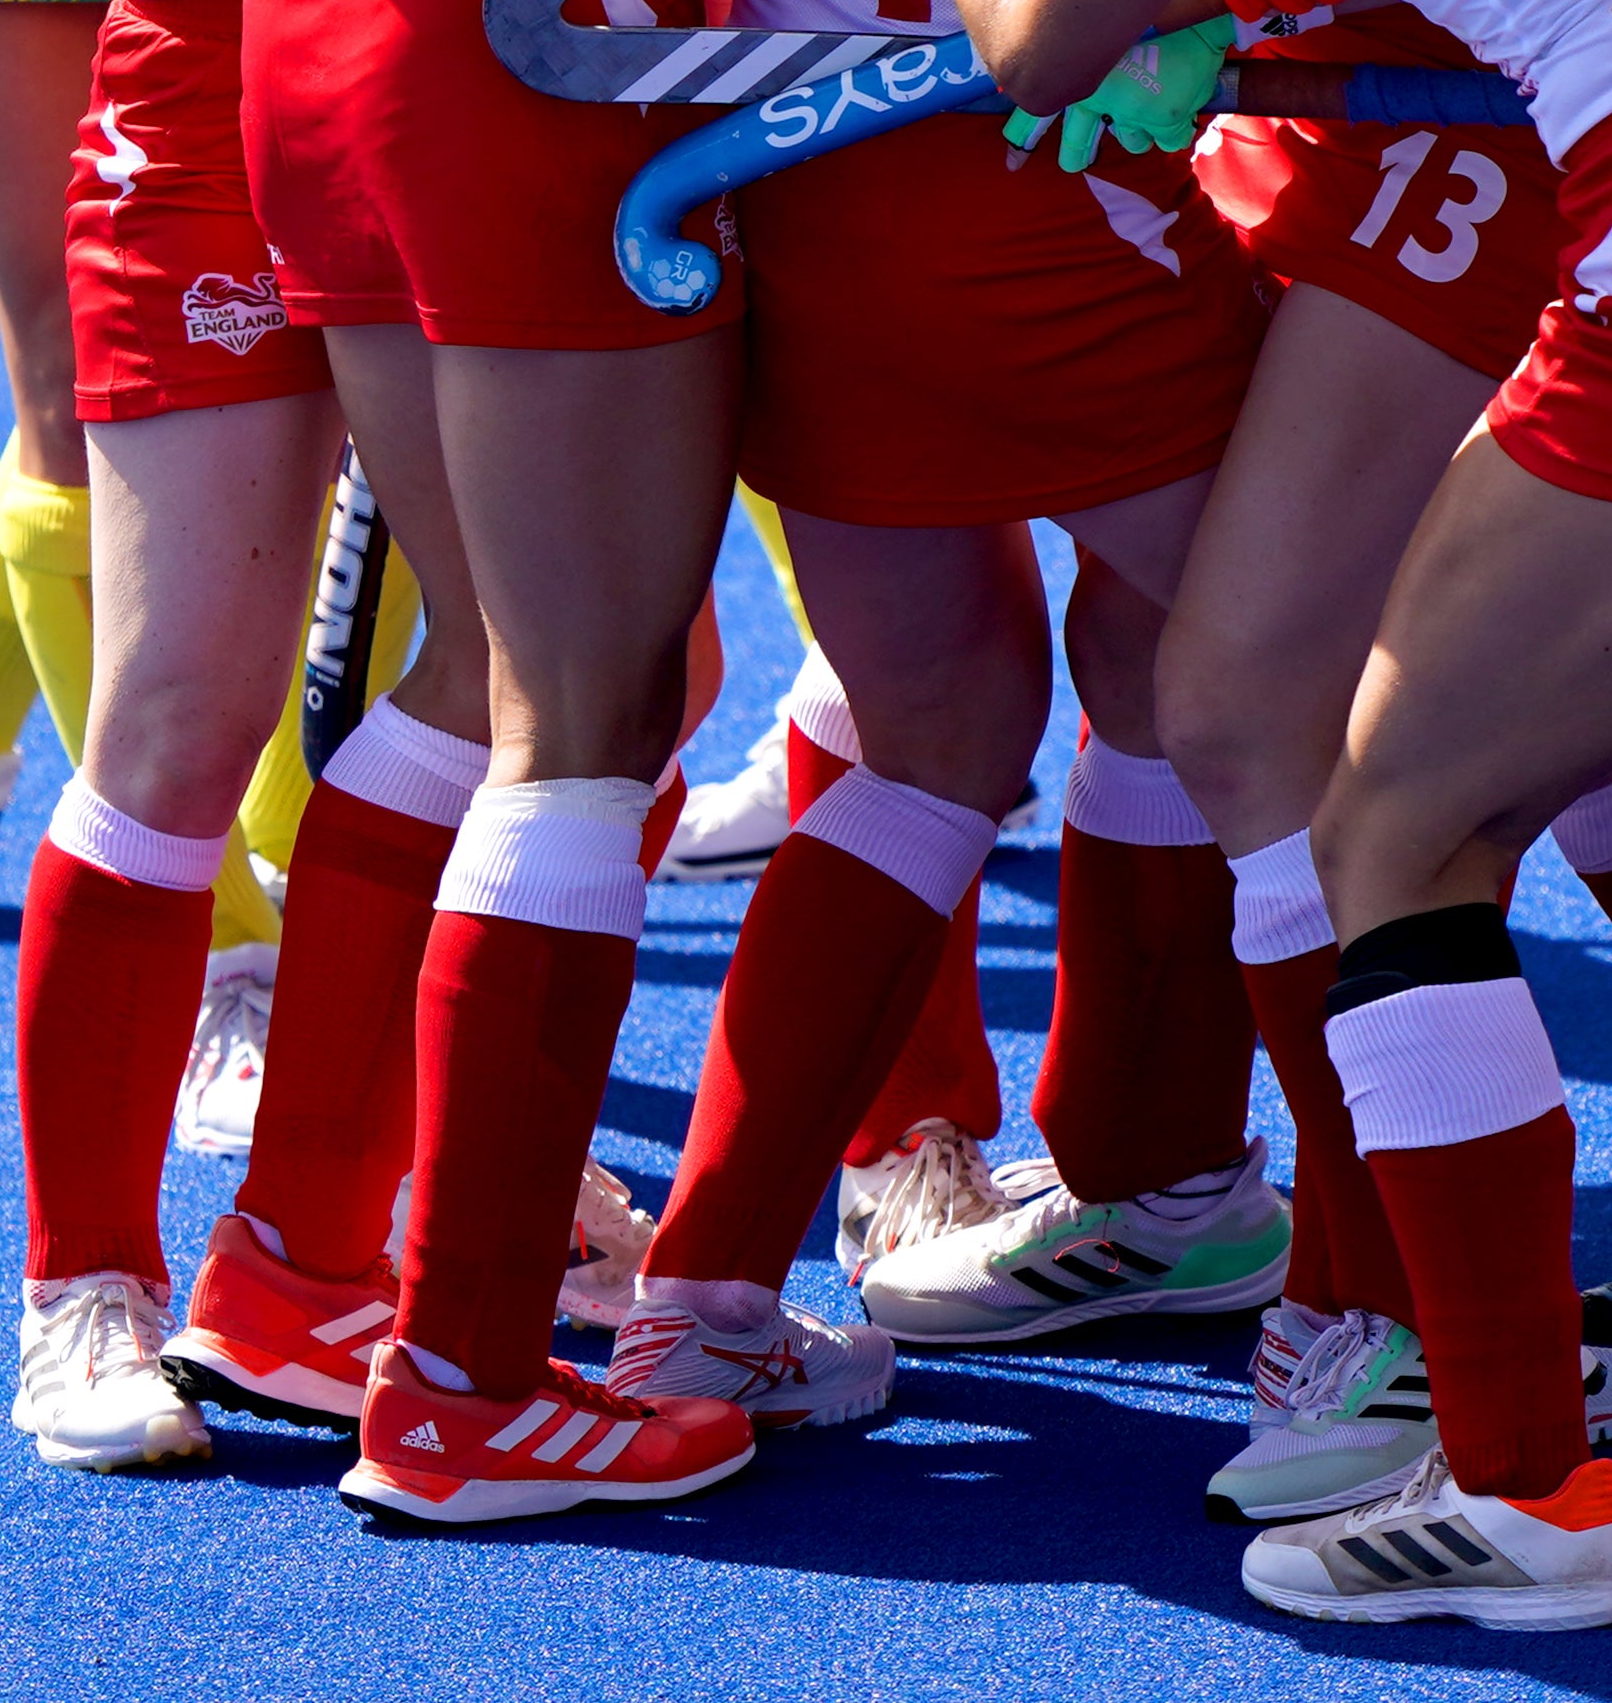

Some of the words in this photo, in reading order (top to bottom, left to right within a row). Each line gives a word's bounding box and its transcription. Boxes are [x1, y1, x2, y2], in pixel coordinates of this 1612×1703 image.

[759, 43, 992, 149] rays
[1349, 130, 1508, 283] 13
[190, 312, 285, 339] ENGLAND
[199, 308, 236, 322] TEAM
[304, 430, 377, 679] HON
[399, 1435, 446, 1454] adidas
